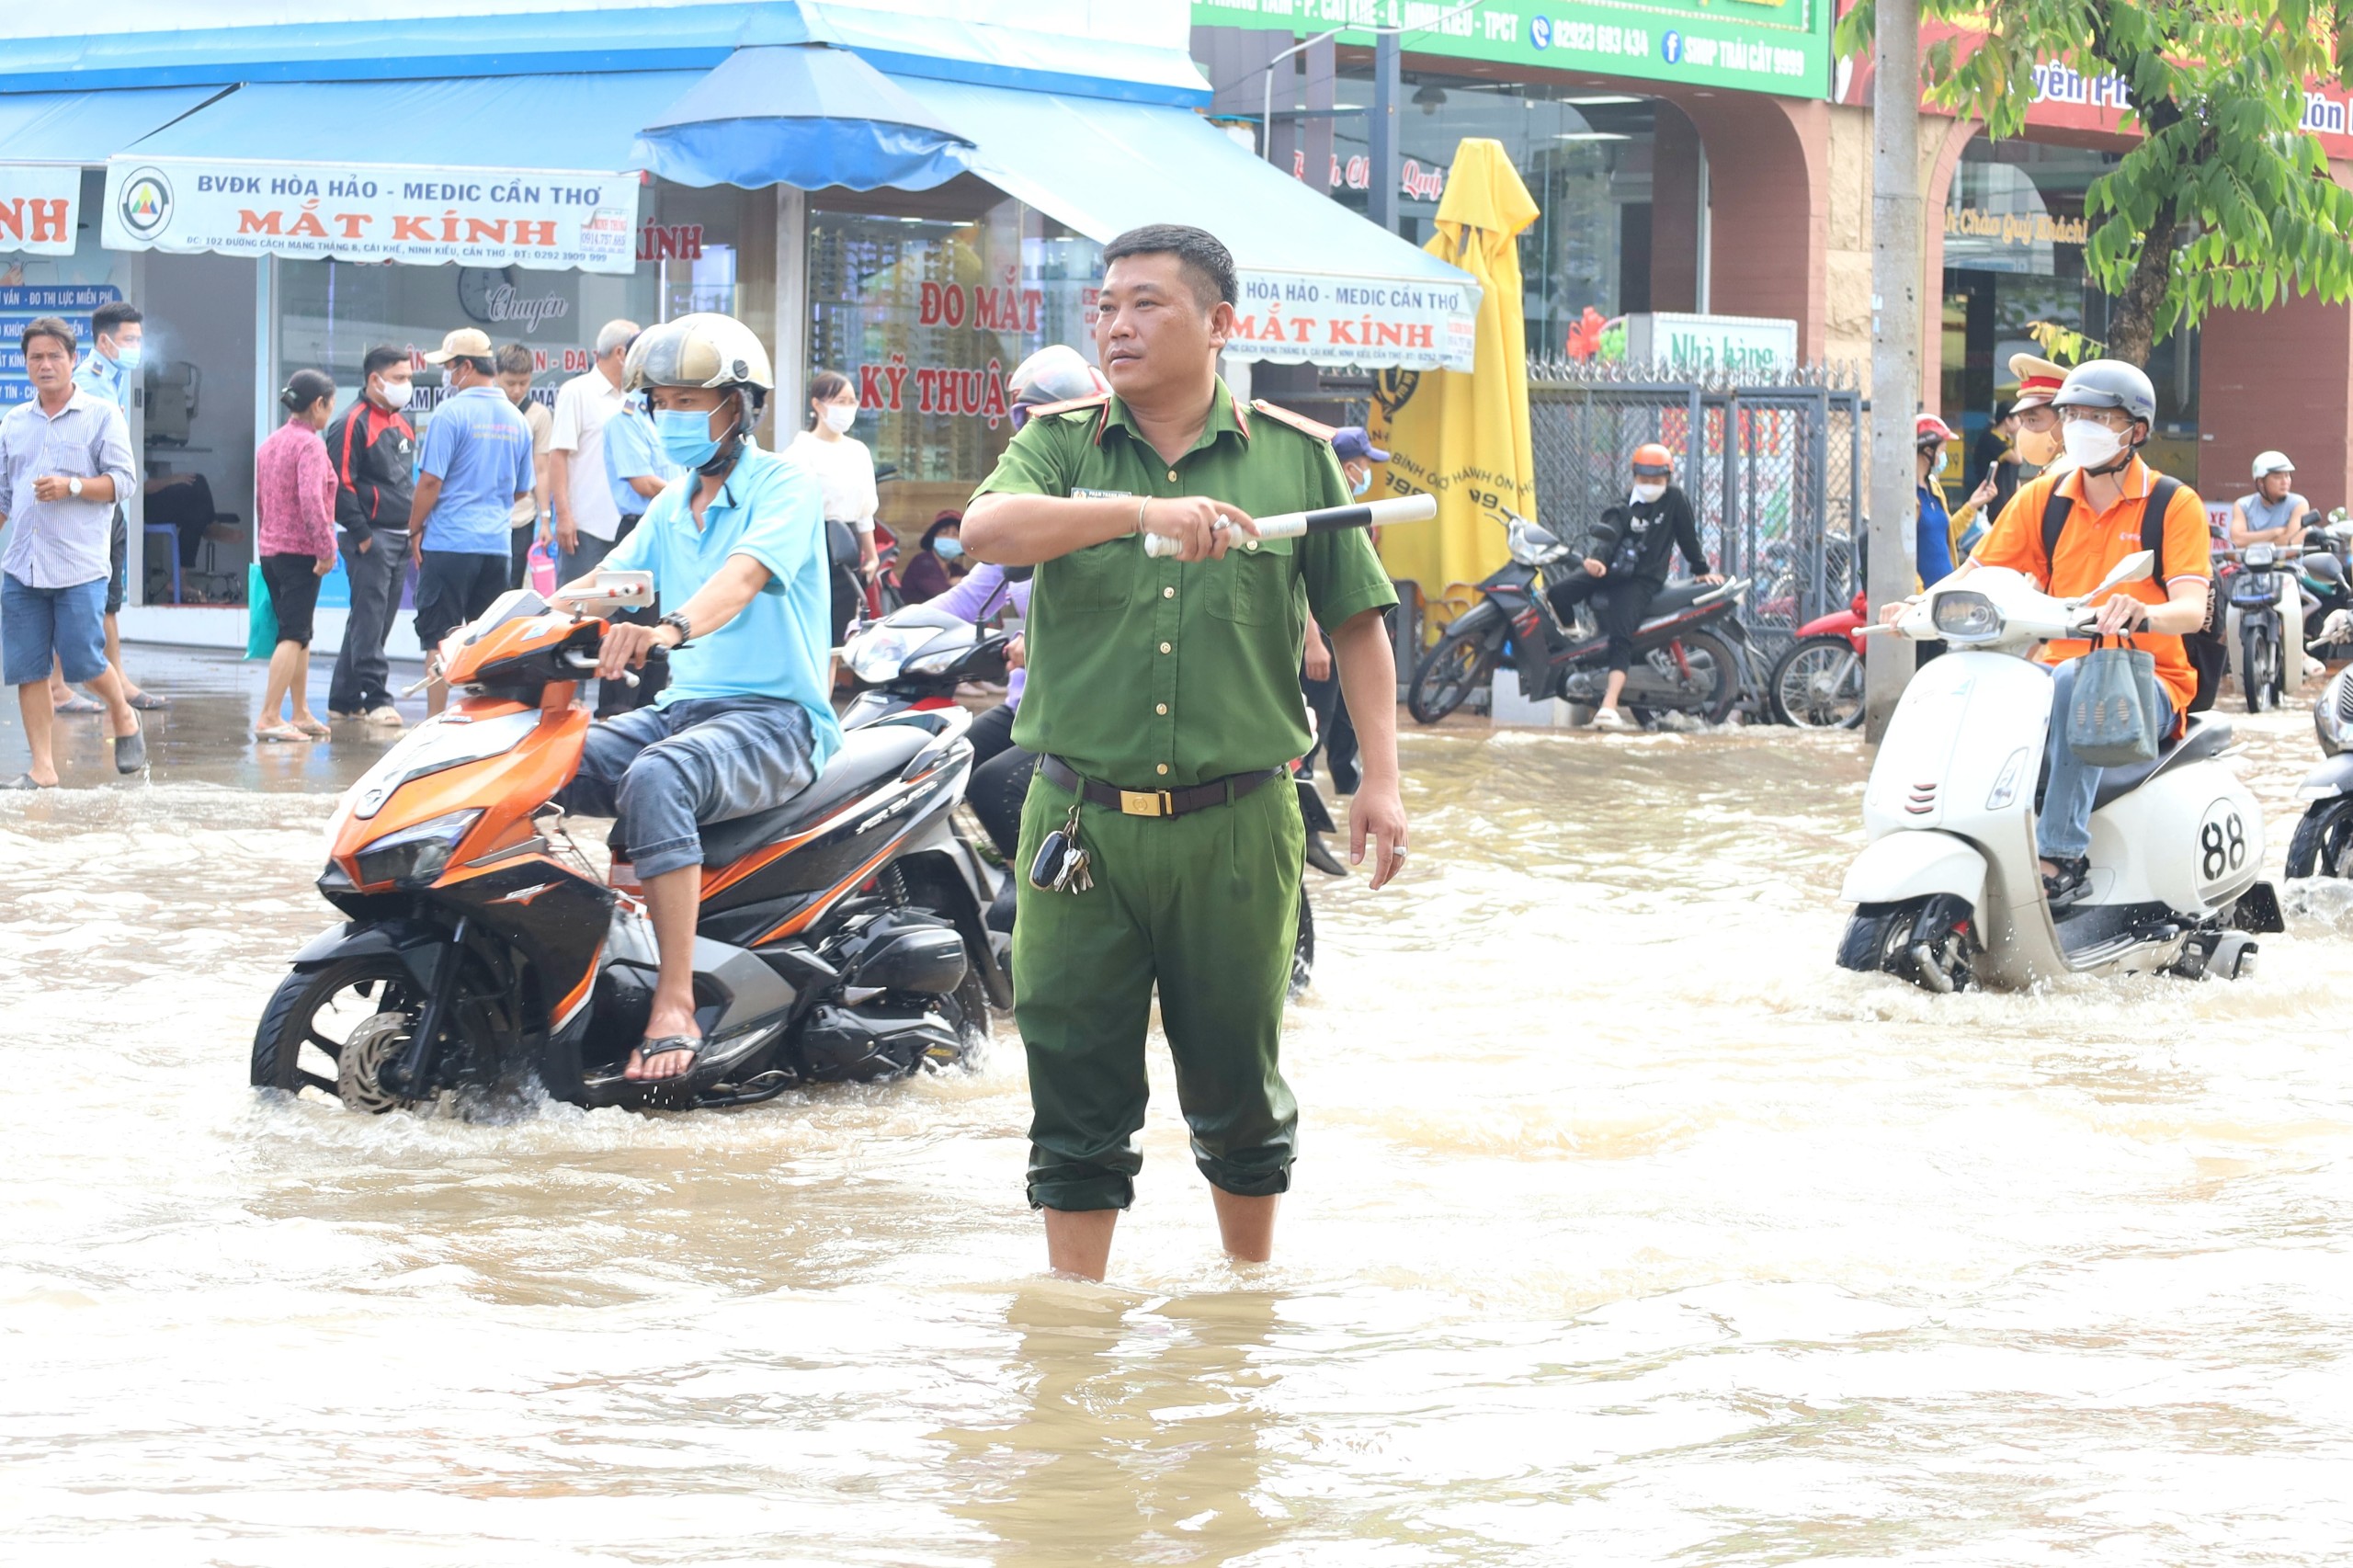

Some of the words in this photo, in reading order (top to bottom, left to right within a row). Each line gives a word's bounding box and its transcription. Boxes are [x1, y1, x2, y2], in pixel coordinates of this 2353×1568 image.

[1483, 10, 1518, 42] TPCT
[1554, 19, 1595, 51] 02923
[1623, 28, 1648, 56] 434
[198, 176, 262, 194] BVĐK
[271, 174, 319, 196] HÒA
[328, 174, 378, 199] HẢO
[404, 183, 481, 202] MEDIC
[491, 178, 540, 203] CẦN
[551, 186, 602, 206] THƠ
[236, 199, 373, 239] MẮT
[392, 210, 558, 246] KÍNH
[1960, 207, 2000, 236] Chào
[2002, 211, 2032, 245] Quý
[206, 236, 222, 246] 102
[260, 237, 285, 249] CÁCH
[288, 240, 315, 251] MẠNG
[318, 241, 348, 252] THÁNG
[364, 243, 380, 253] CÁI
[409, 245, 432, 256] NINH
[463, 246, 483, 257] CẦN
[534, 249, 560, 260] 0292
[563, 251, 585, 262] 3909
[29, 291, 41, 305] ĐO
[485, 283, 569, 334] Chuyên
[919, 282, 965, 328] ĐO
[973, 265, 1042, 333] MẮT
[1246, 278, 1280, 301] HÒA
[1286, 278, 1319, 302] HẢO
[1336, 287, 1385, 306] MEDIC
[1391, 284, 1423, 308] CẦN
[1428, 292, 1460, 311] THƠ
[1228, 302, 1316, 343] MẮT
[1328, 313, 1435, 348] KÍNH
[1671, 333, 1714, 369] Nhà
[1723, 335, 1775, 381] hàng
[859, 353, 908, 412] KỸ
[2201, 812, 2245, 881] 88
